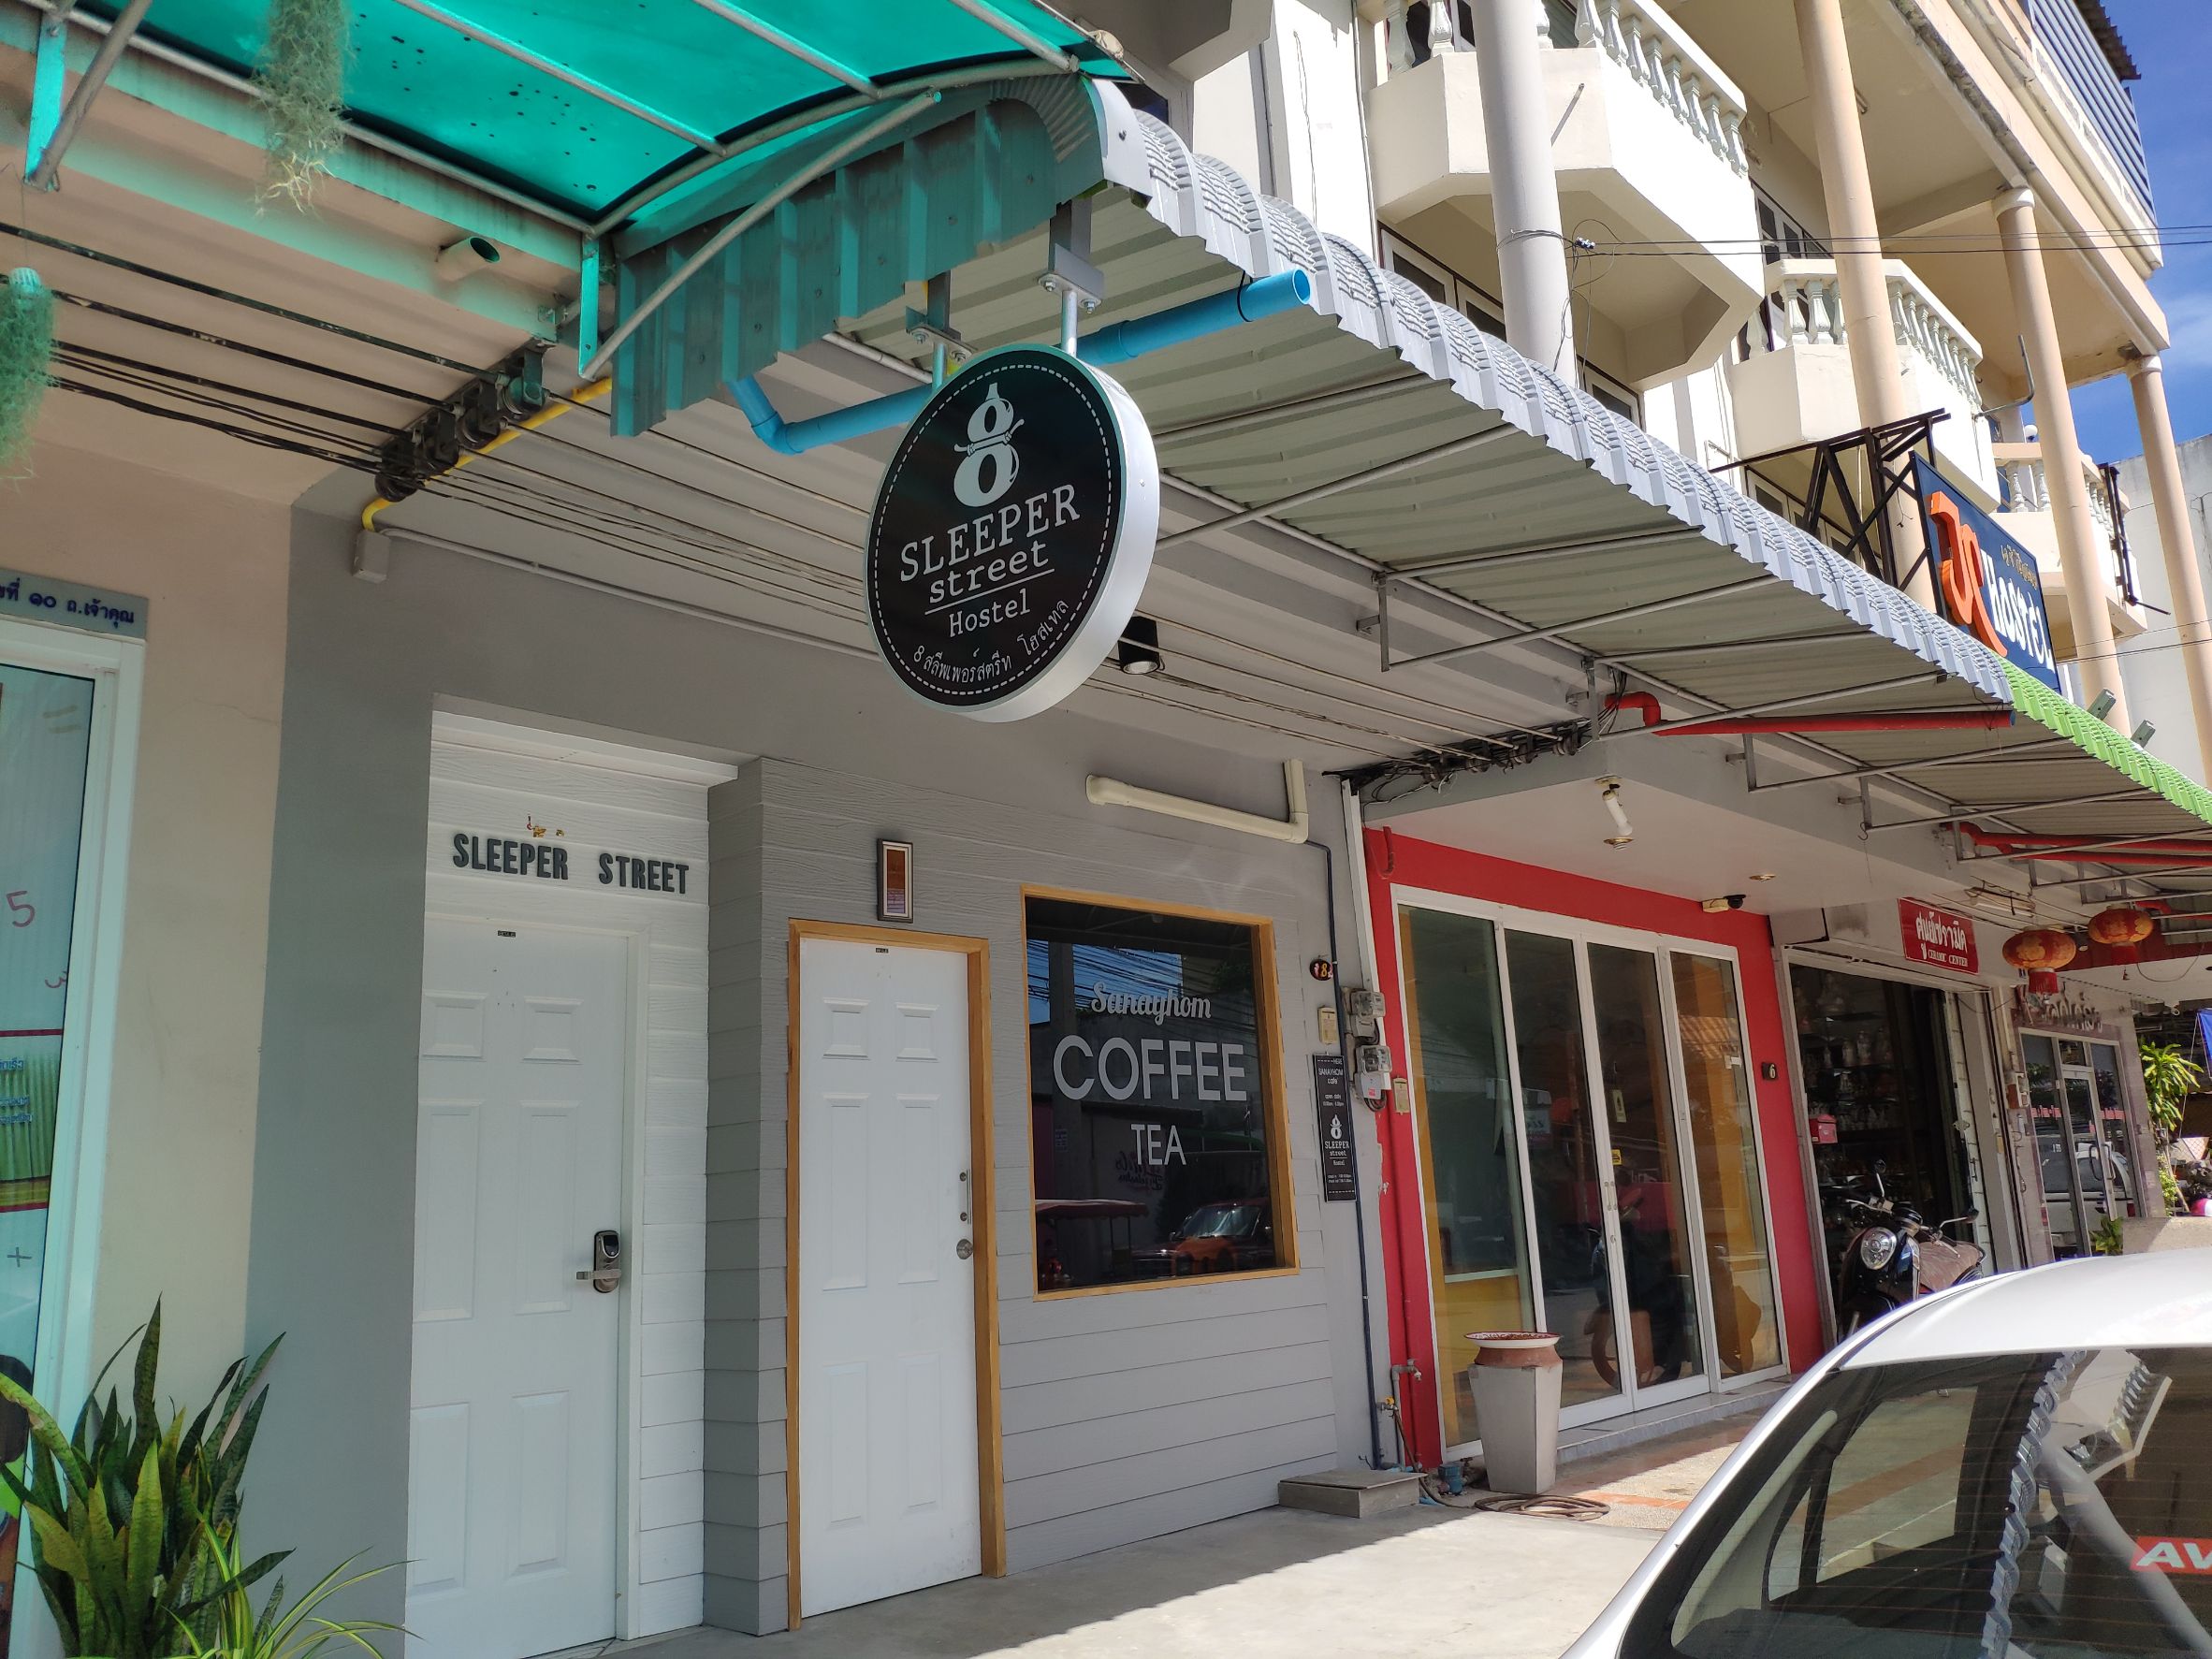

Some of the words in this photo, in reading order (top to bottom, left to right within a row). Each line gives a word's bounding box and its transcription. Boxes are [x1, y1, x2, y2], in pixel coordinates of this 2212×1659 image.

[899, 483, 1081, 582] SLEEPER
[928, 540, 1050, 605] street
[913, 645, 925, 663] 8
[1016, 598, 1070, 656] โฮสเทล
[948, 588, 1032, 638] Hostel
[453, 833, 569, 880] SLEEPER
[599, 852, 690, 895] STREET
[1948, 954, 1969, 968] CENTER
[1091, 982, 1212, 1026] Sanayhom
[1053, 1034, 1248, 1101] COFFEE
[1768, 1063, 1776, 1079] 6
[1130, 1124, 1186, 1166] TEA
[1324, 1141, 1350, 1149] SLEEPER
